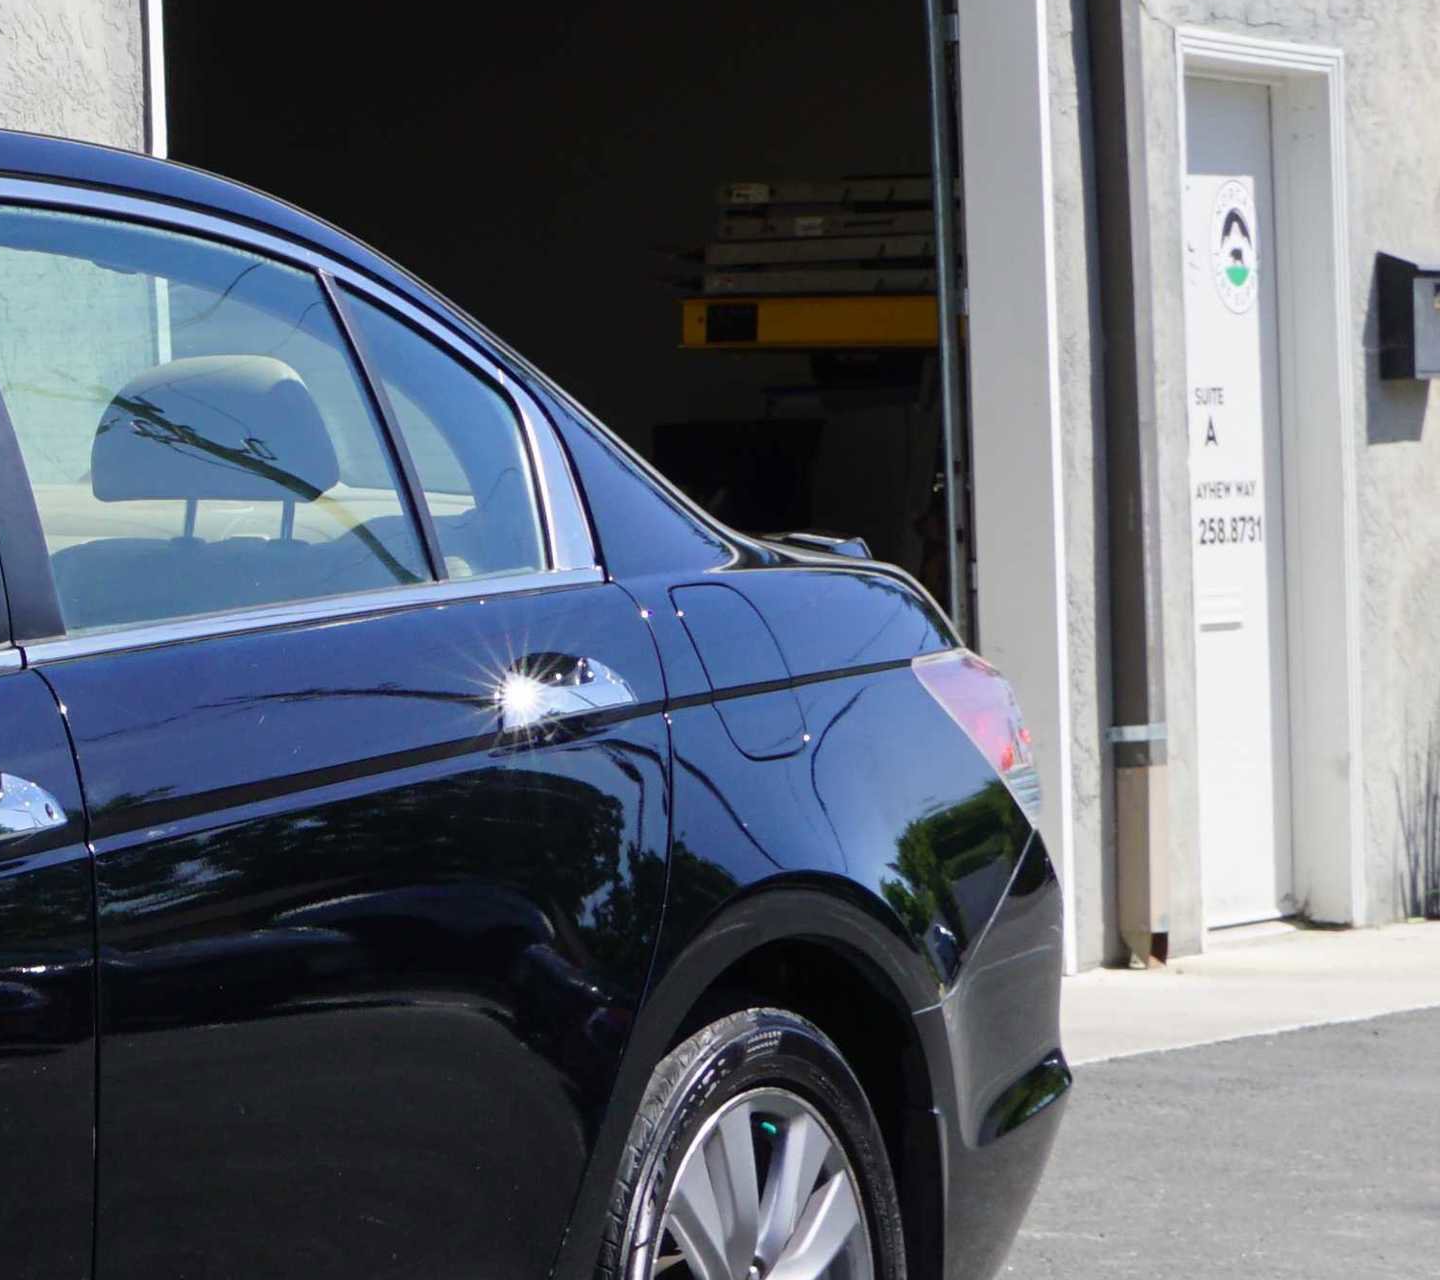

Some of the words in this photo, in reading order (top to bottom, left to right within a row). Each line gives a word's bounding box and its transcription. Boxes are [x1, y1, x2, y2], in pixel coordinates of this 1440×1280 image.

[1194, 386, 1224, 406] SUITE
[1204, 415, 1219, 447] A
[1235, 480, 1257, 498] WAY
[1197, 515, 1263, 545] 258.8731
